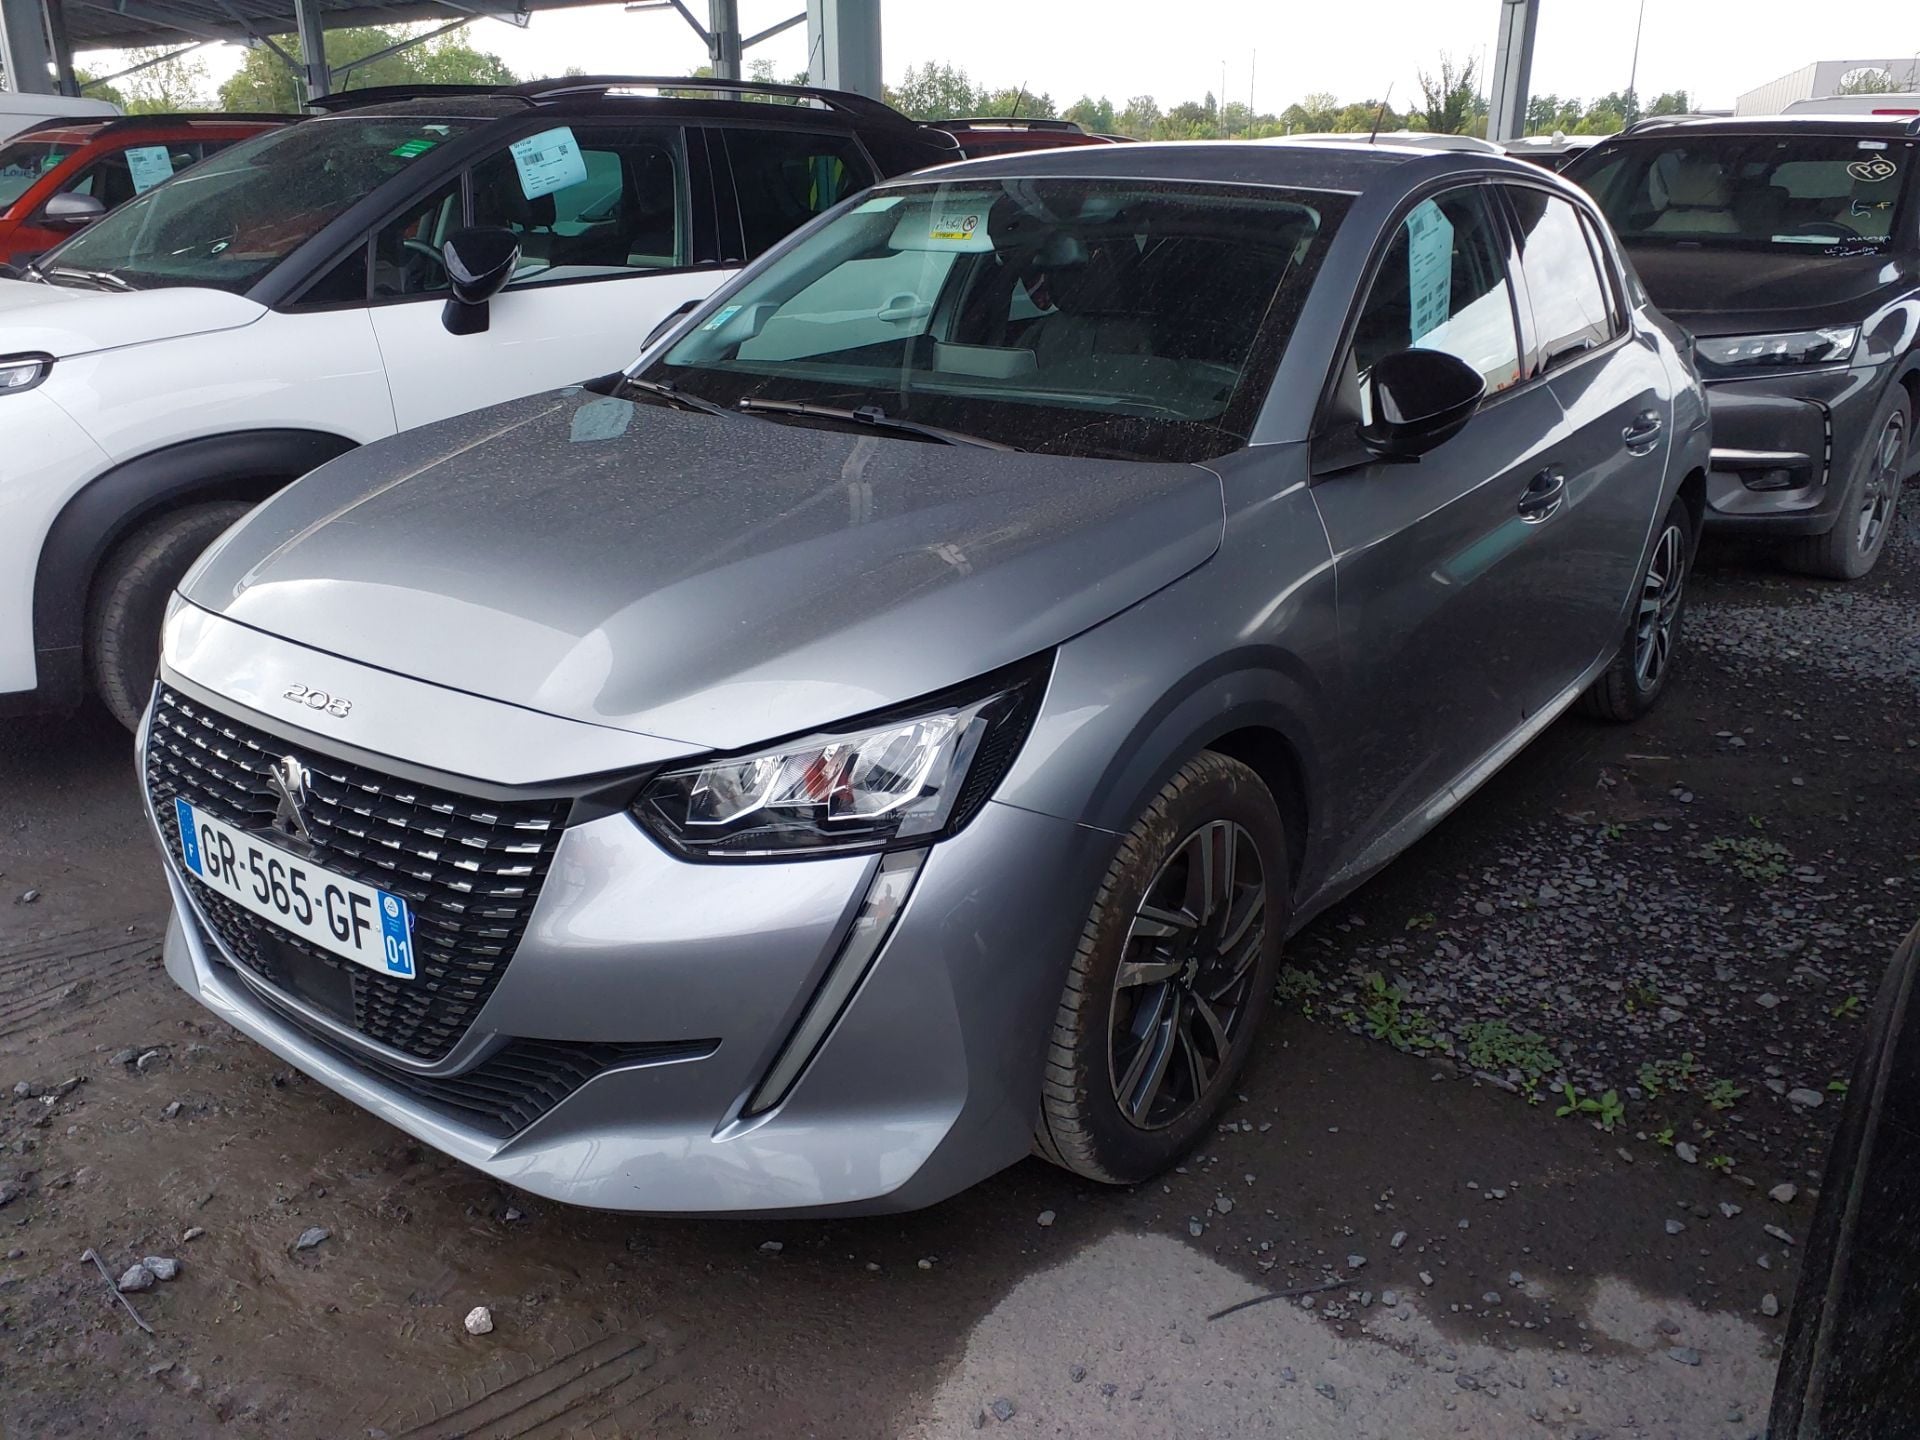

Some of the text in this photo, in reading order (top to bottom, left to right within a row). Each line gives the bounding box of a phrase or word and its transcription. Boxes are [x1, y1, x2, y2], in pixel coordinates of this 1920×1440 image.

[283, 682, 353, 719] 208
[188, 841, 195, 858] F
[200, 823, 371, 949] GR-565-GF
[386, 935, 409, 969] 01
